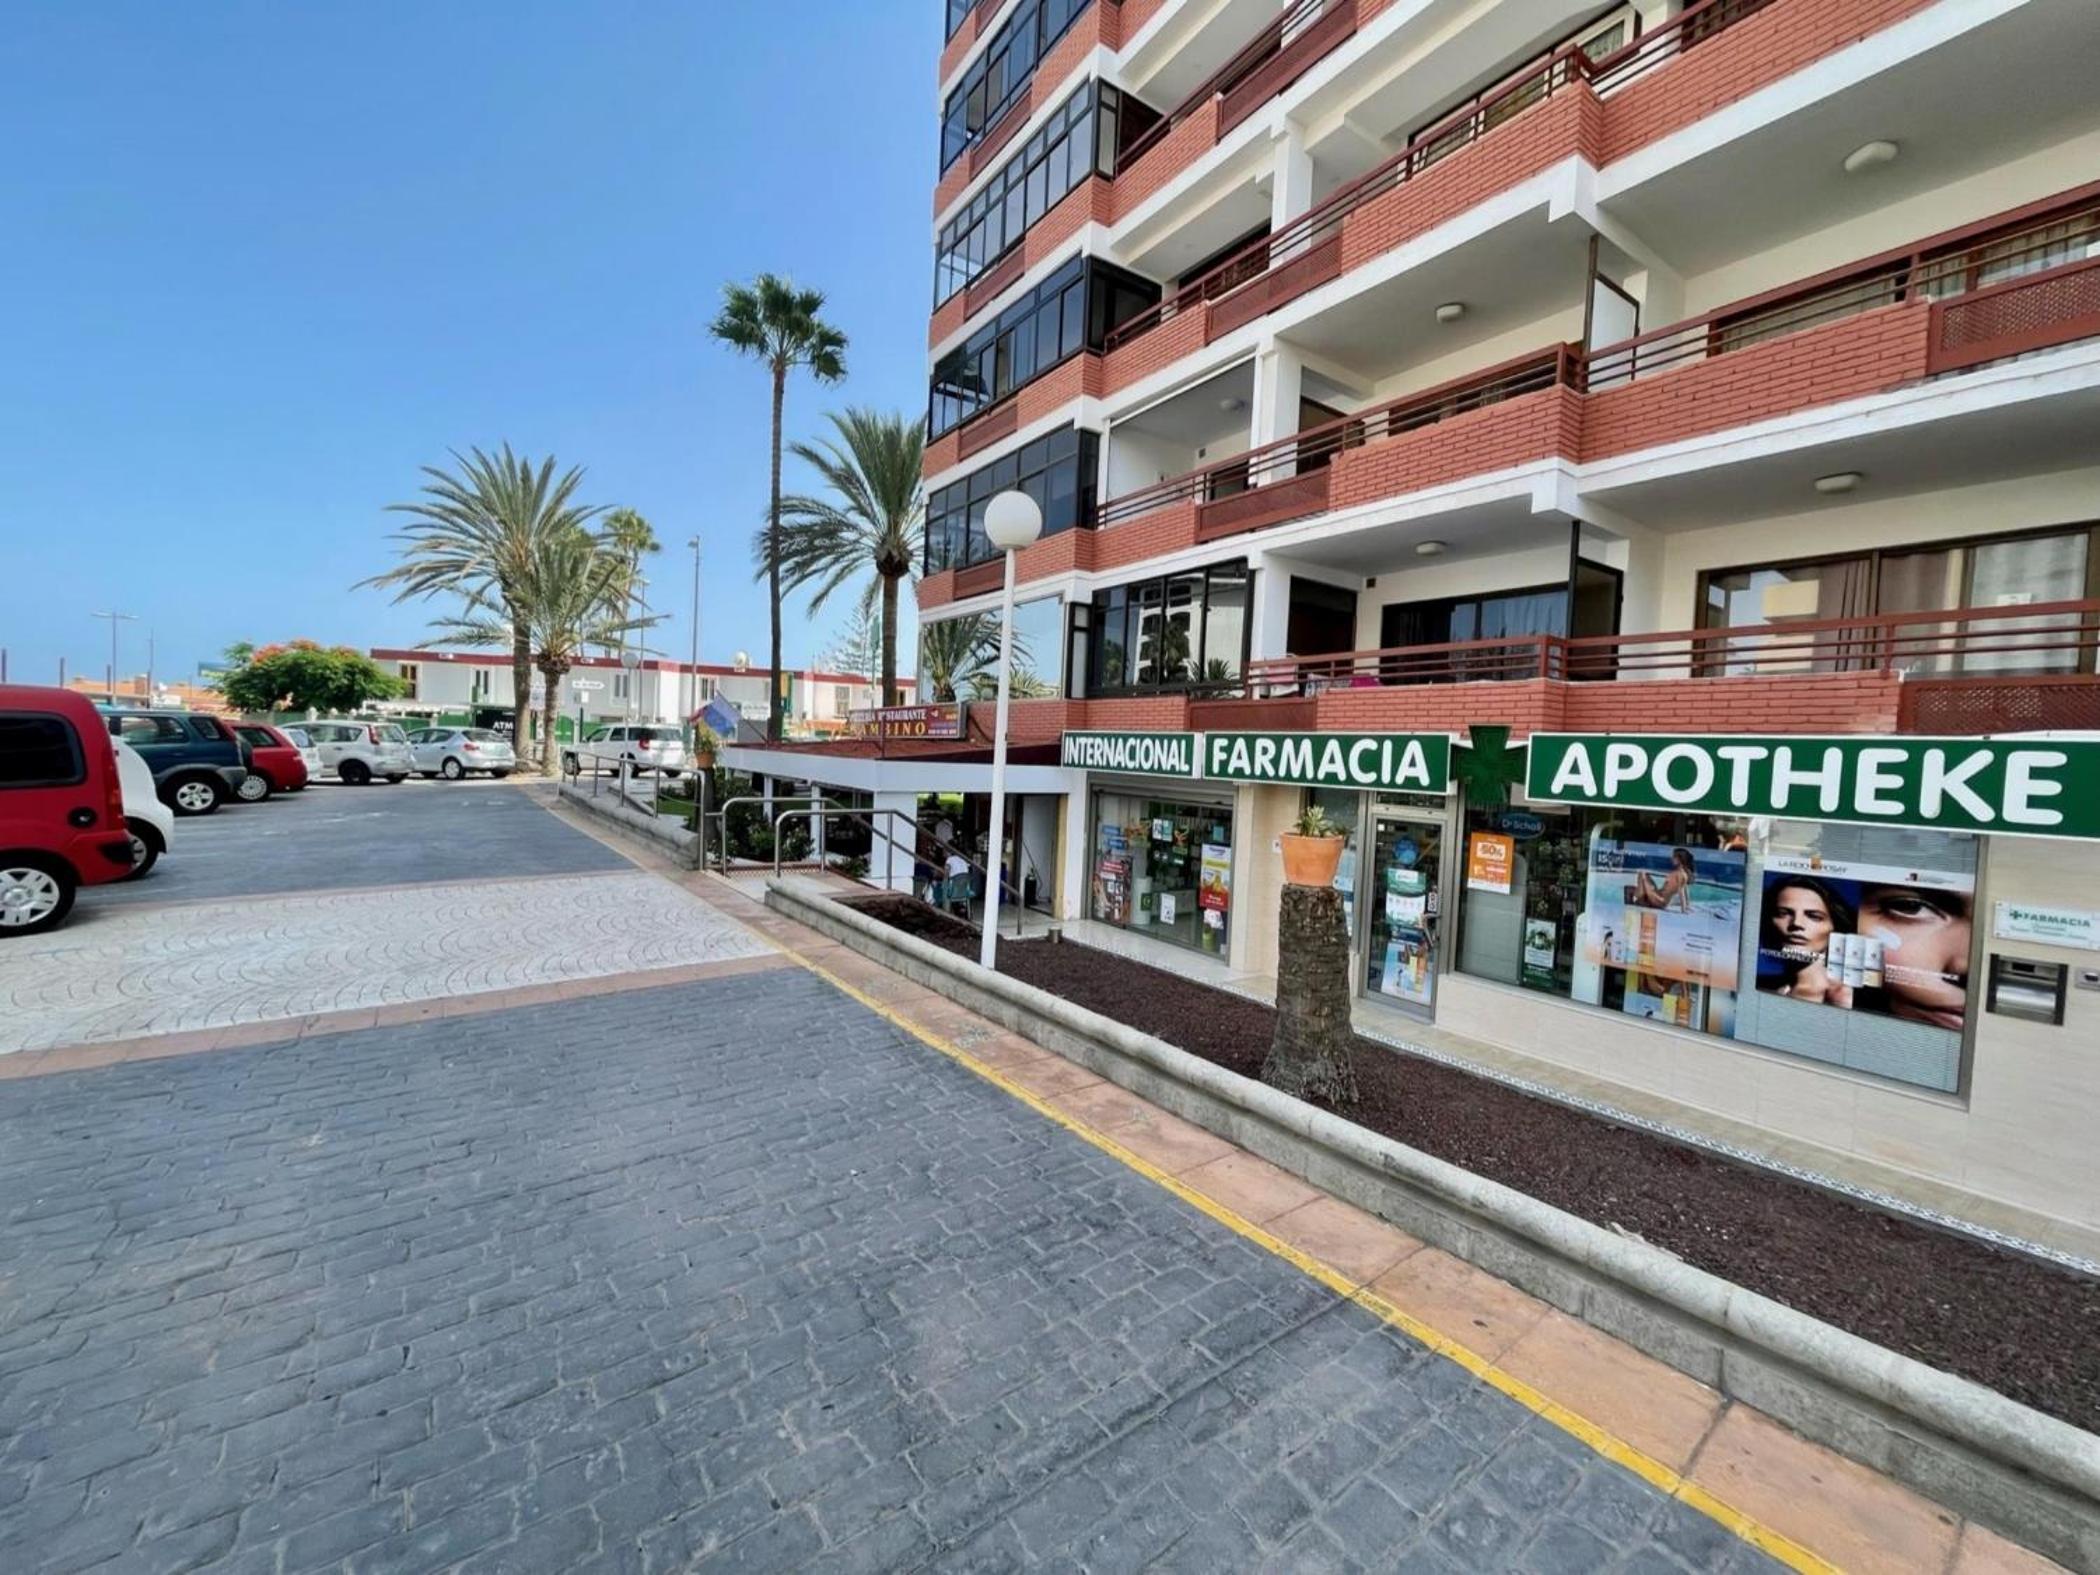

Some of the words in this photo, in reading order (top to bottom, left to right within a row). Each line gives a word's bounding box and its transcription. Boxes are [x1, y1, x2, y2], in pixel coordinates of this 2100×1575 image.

[493, 720, 514, 730] ATM
[1064, 736, 1190, 772] INTERNACIONAL
[1212, 737, 1431, 787] FARMACIA
[1551, 742, 2068, 826] APOTHEKE
[2024, 912, 2091, 928] FARMACIA
